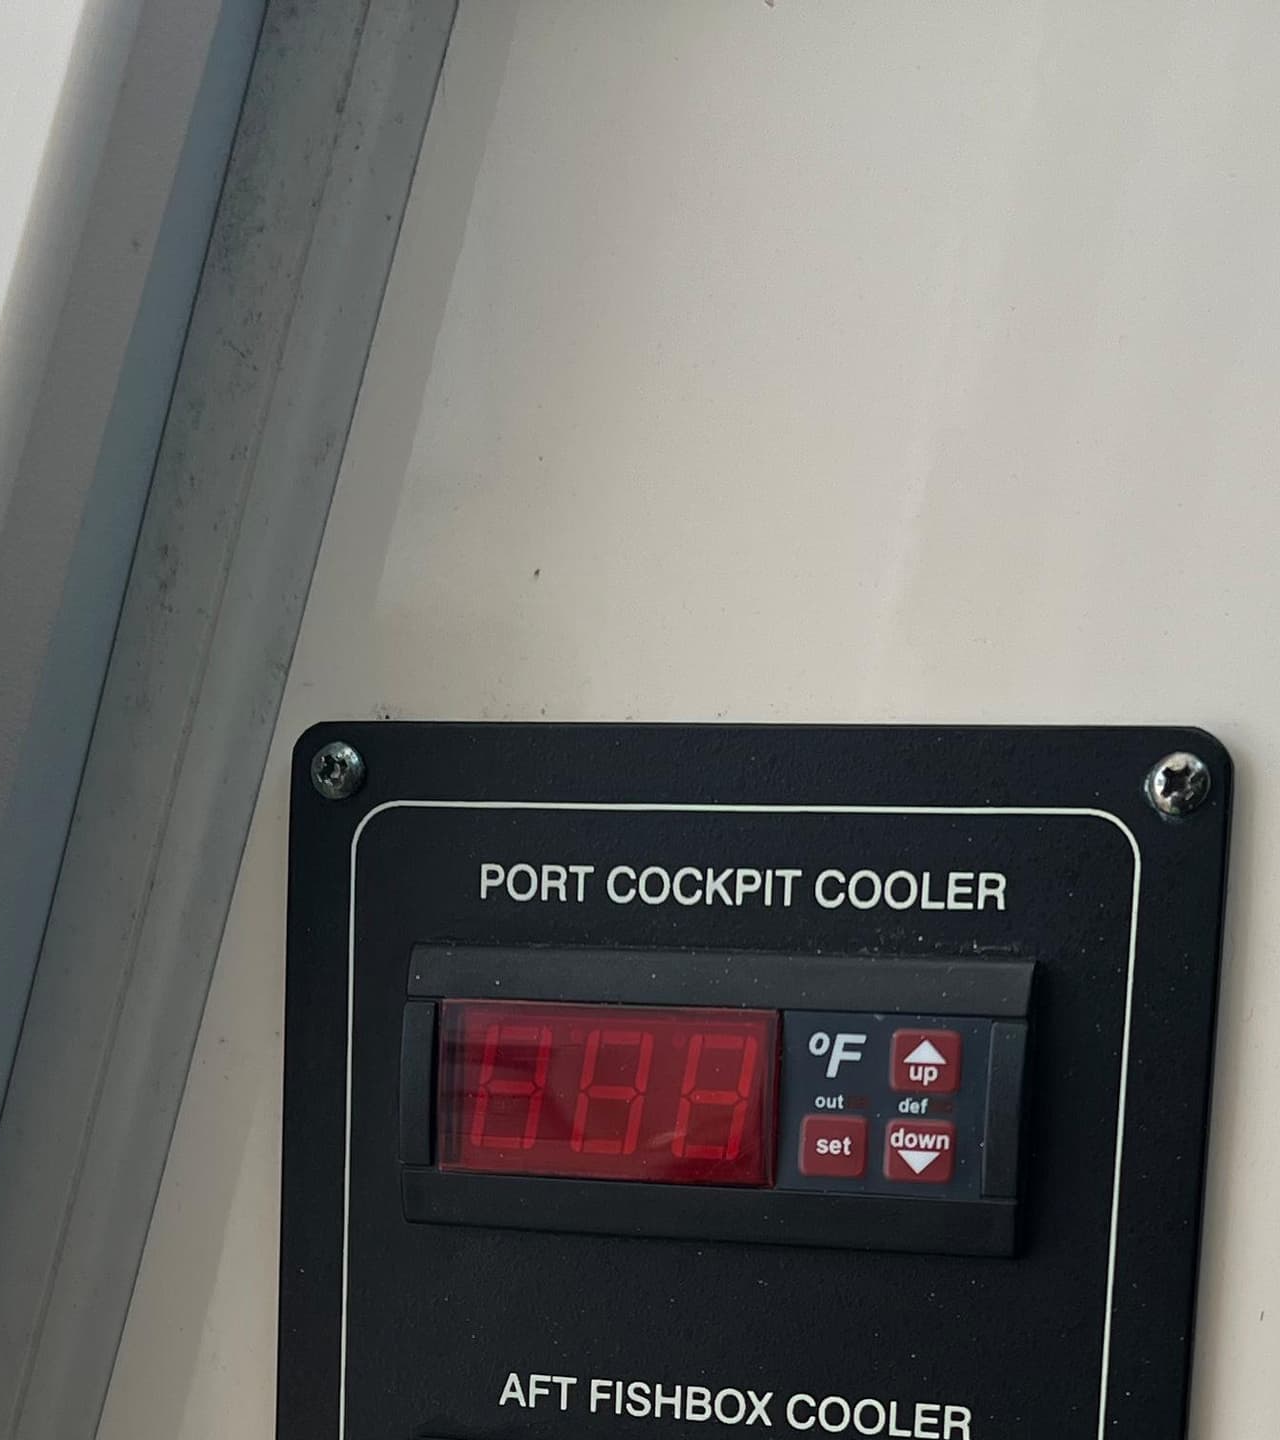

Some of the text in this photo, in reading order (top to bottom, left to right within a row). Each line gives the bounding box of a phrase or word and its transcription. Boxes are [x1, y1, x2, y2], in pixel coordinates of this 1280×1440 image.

[480, 862, 1007, 911] PORT COCKPIT COOLER
[909, 1065, 939, 1086] up
[814, 1094, 844, 1110] out
[898, 1097, 929, 1114] def
[815, 1136, 852, 1156] set
[890, 1127, 950, 1150] down
[498, 1372, 578, 1411] AFT
[590, 1378, 774, 1427] FISHBOX
